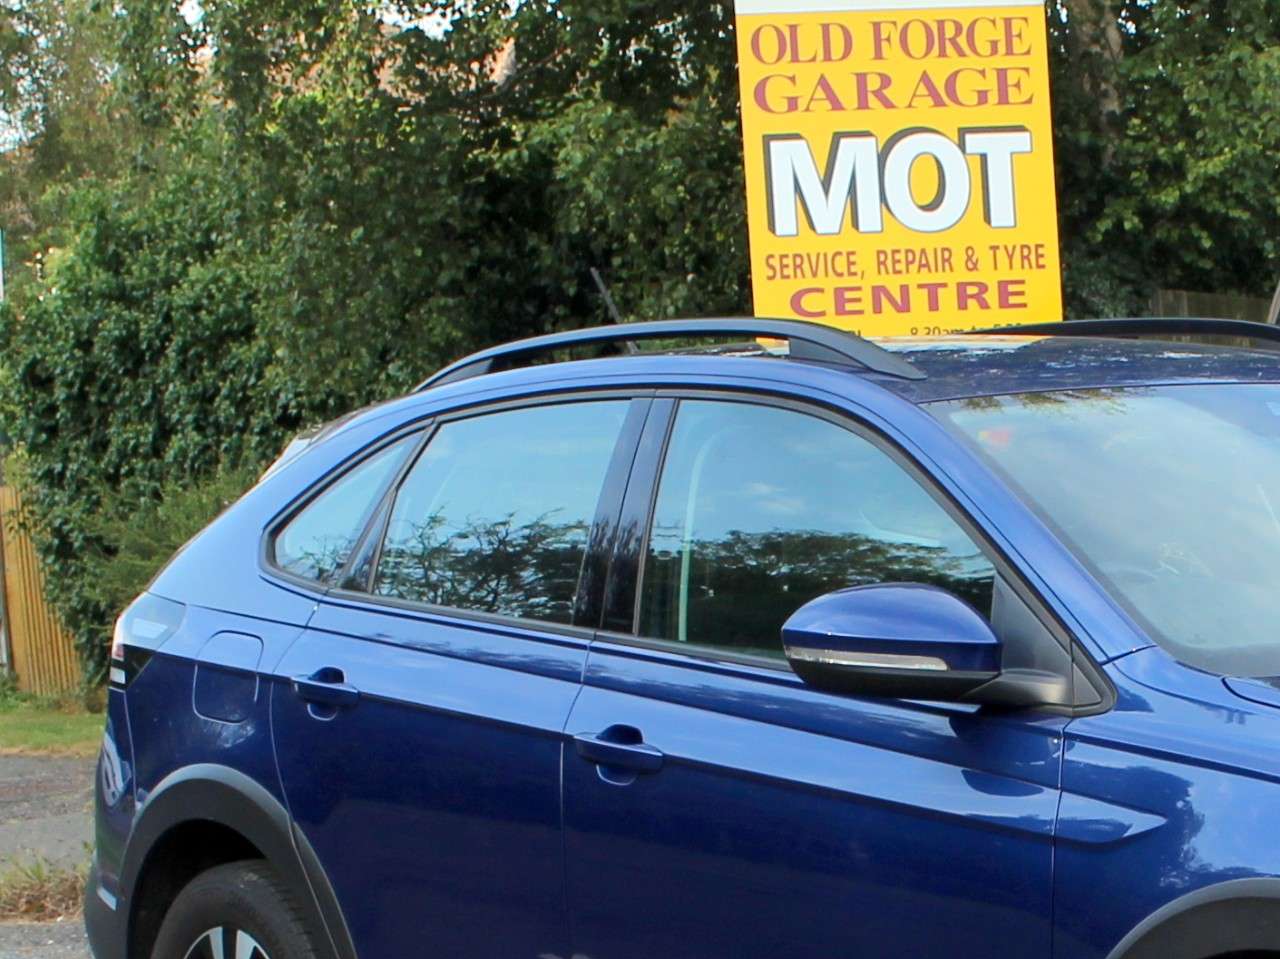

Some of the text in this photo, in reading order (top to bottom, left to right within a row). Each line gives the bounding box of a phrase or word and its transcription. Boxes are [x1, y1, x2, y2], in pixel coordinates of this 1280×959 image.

[751, 16, 1032, 65] OLD FORGE
[753, 67, 1035, 114] GARAGE
[762, 125, 1033, 237] MOT
[765, 244, 1047, 281] SERVICE, REPAIR & TYRE
[790, 279, 1028, 317] CENTRE
